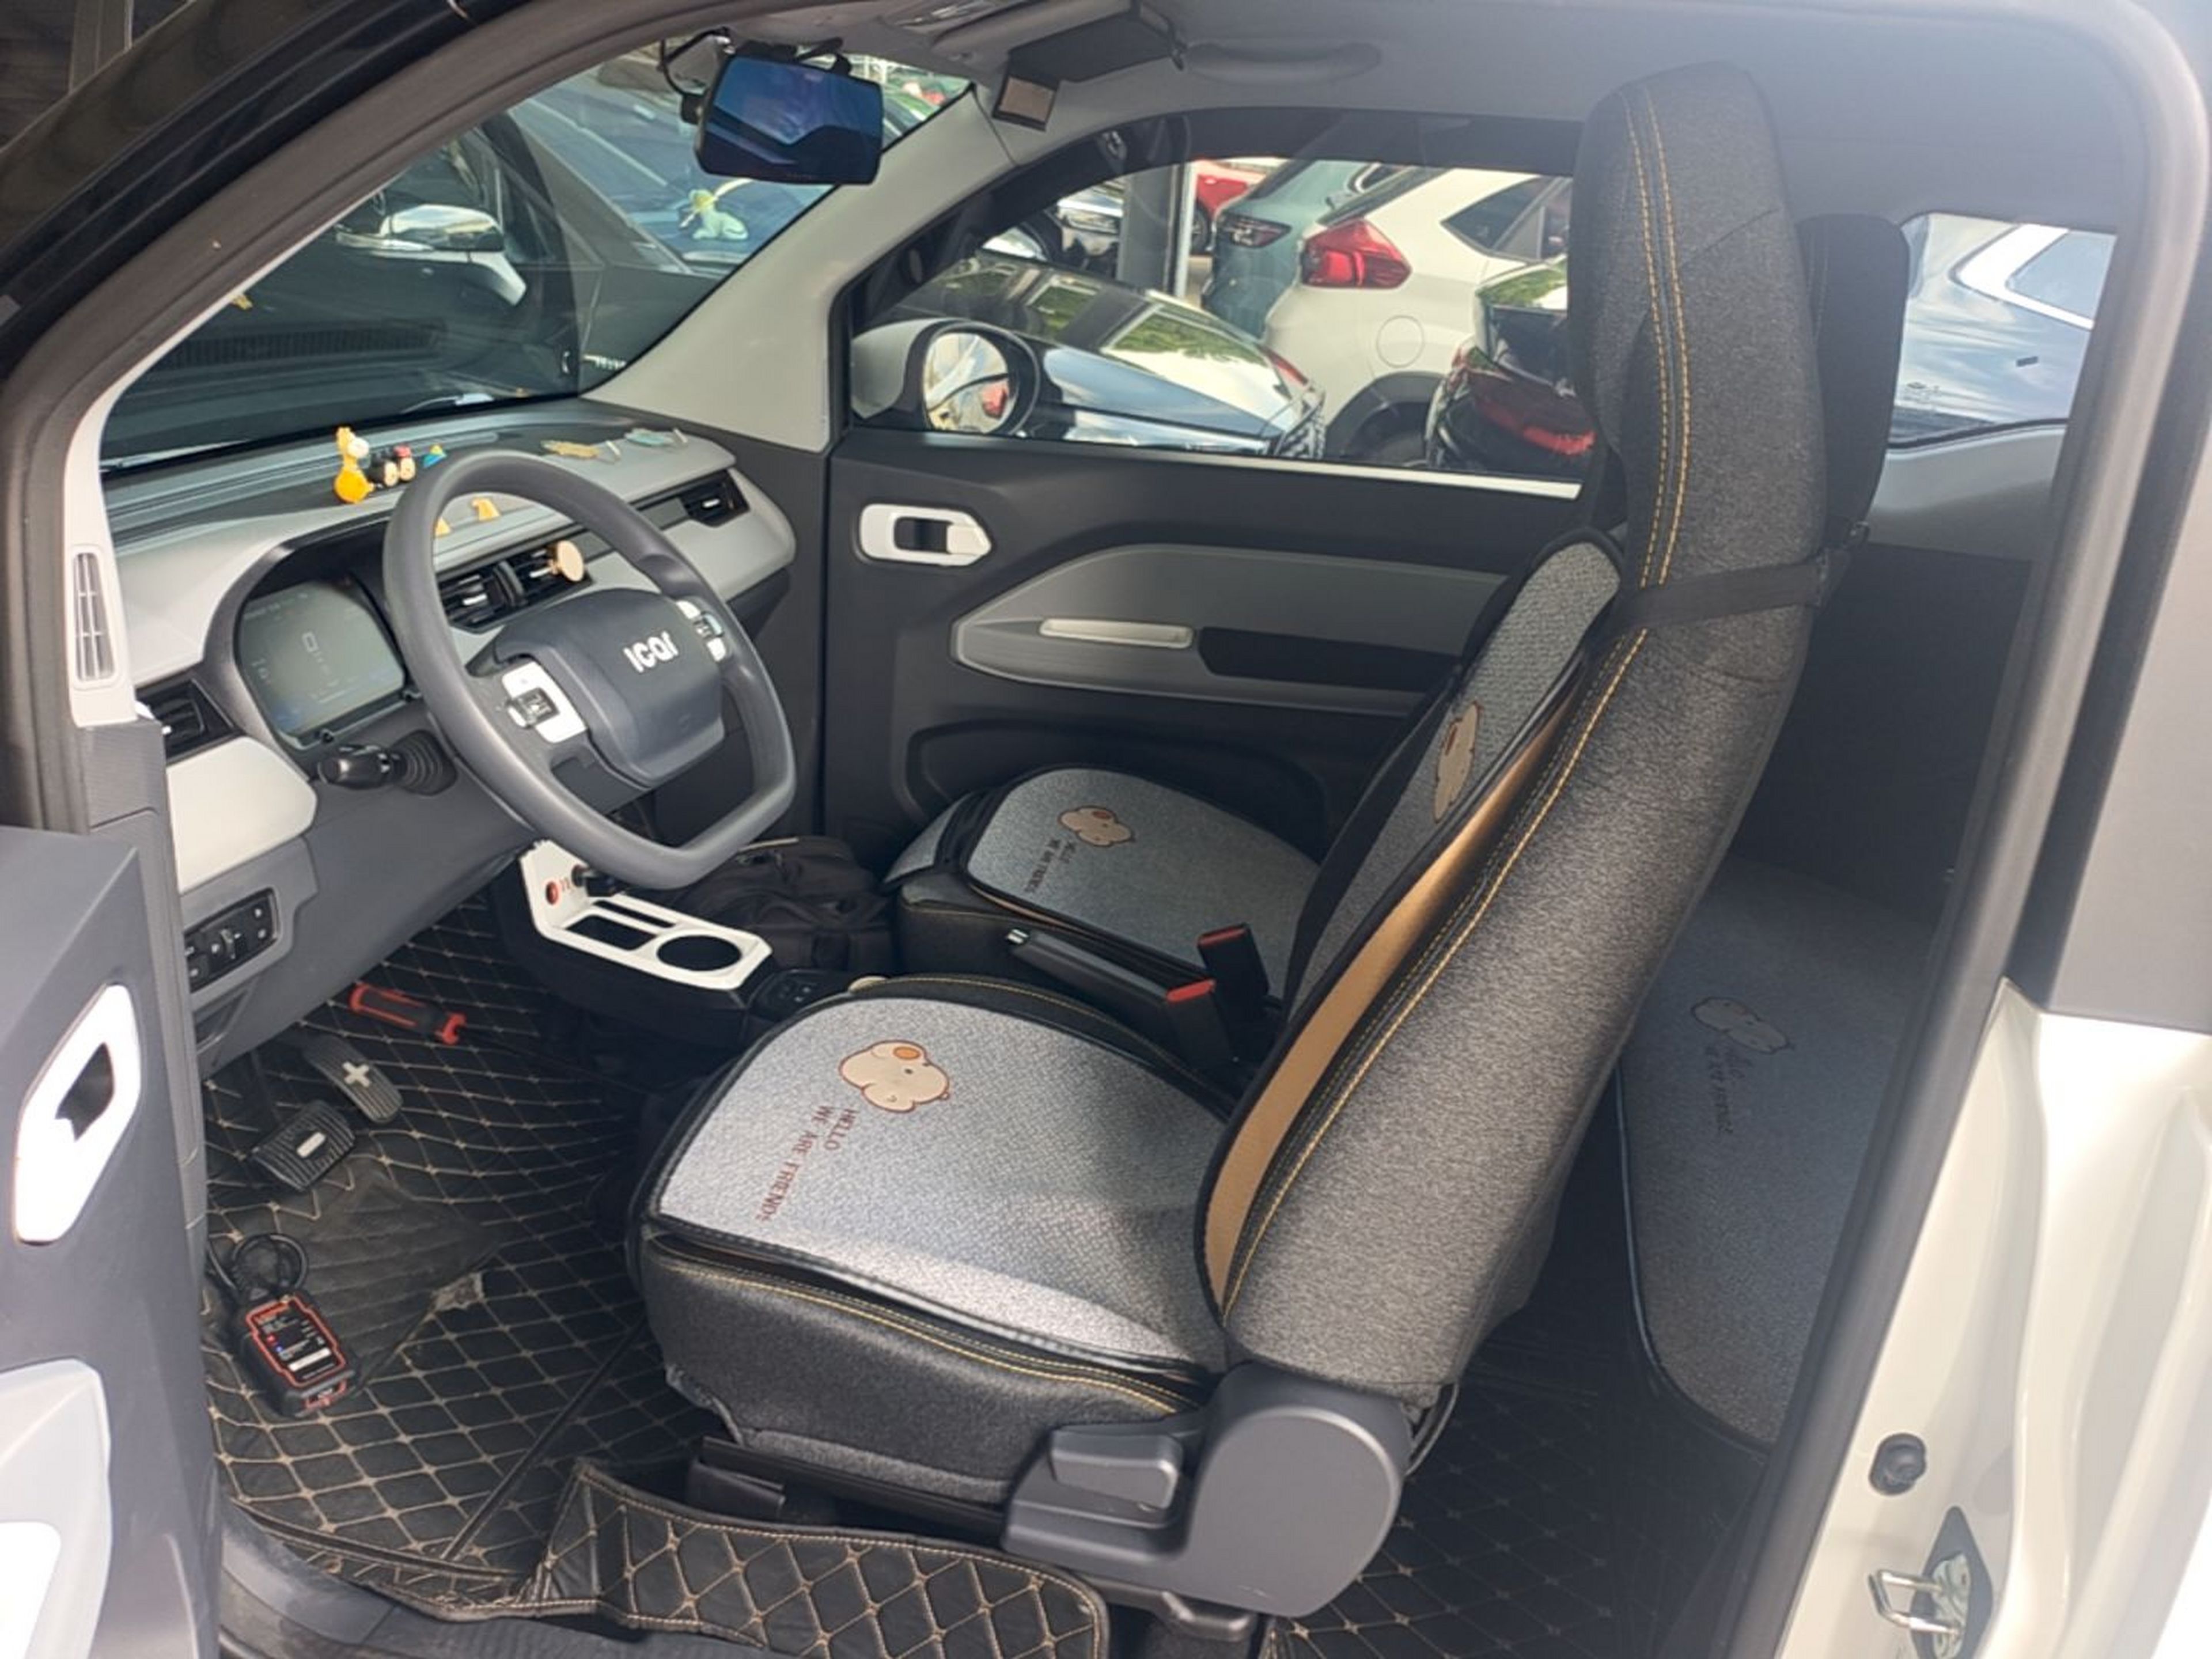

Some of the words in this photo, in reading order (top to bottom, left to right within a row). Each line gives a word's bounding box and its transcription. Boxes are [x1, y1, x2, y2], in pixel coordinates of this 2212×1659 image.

[811, 1105, 835, 1124] WE
[824, 1107, 860, 1151] HELLO
[791, 1130, 819, 1154] ARE
